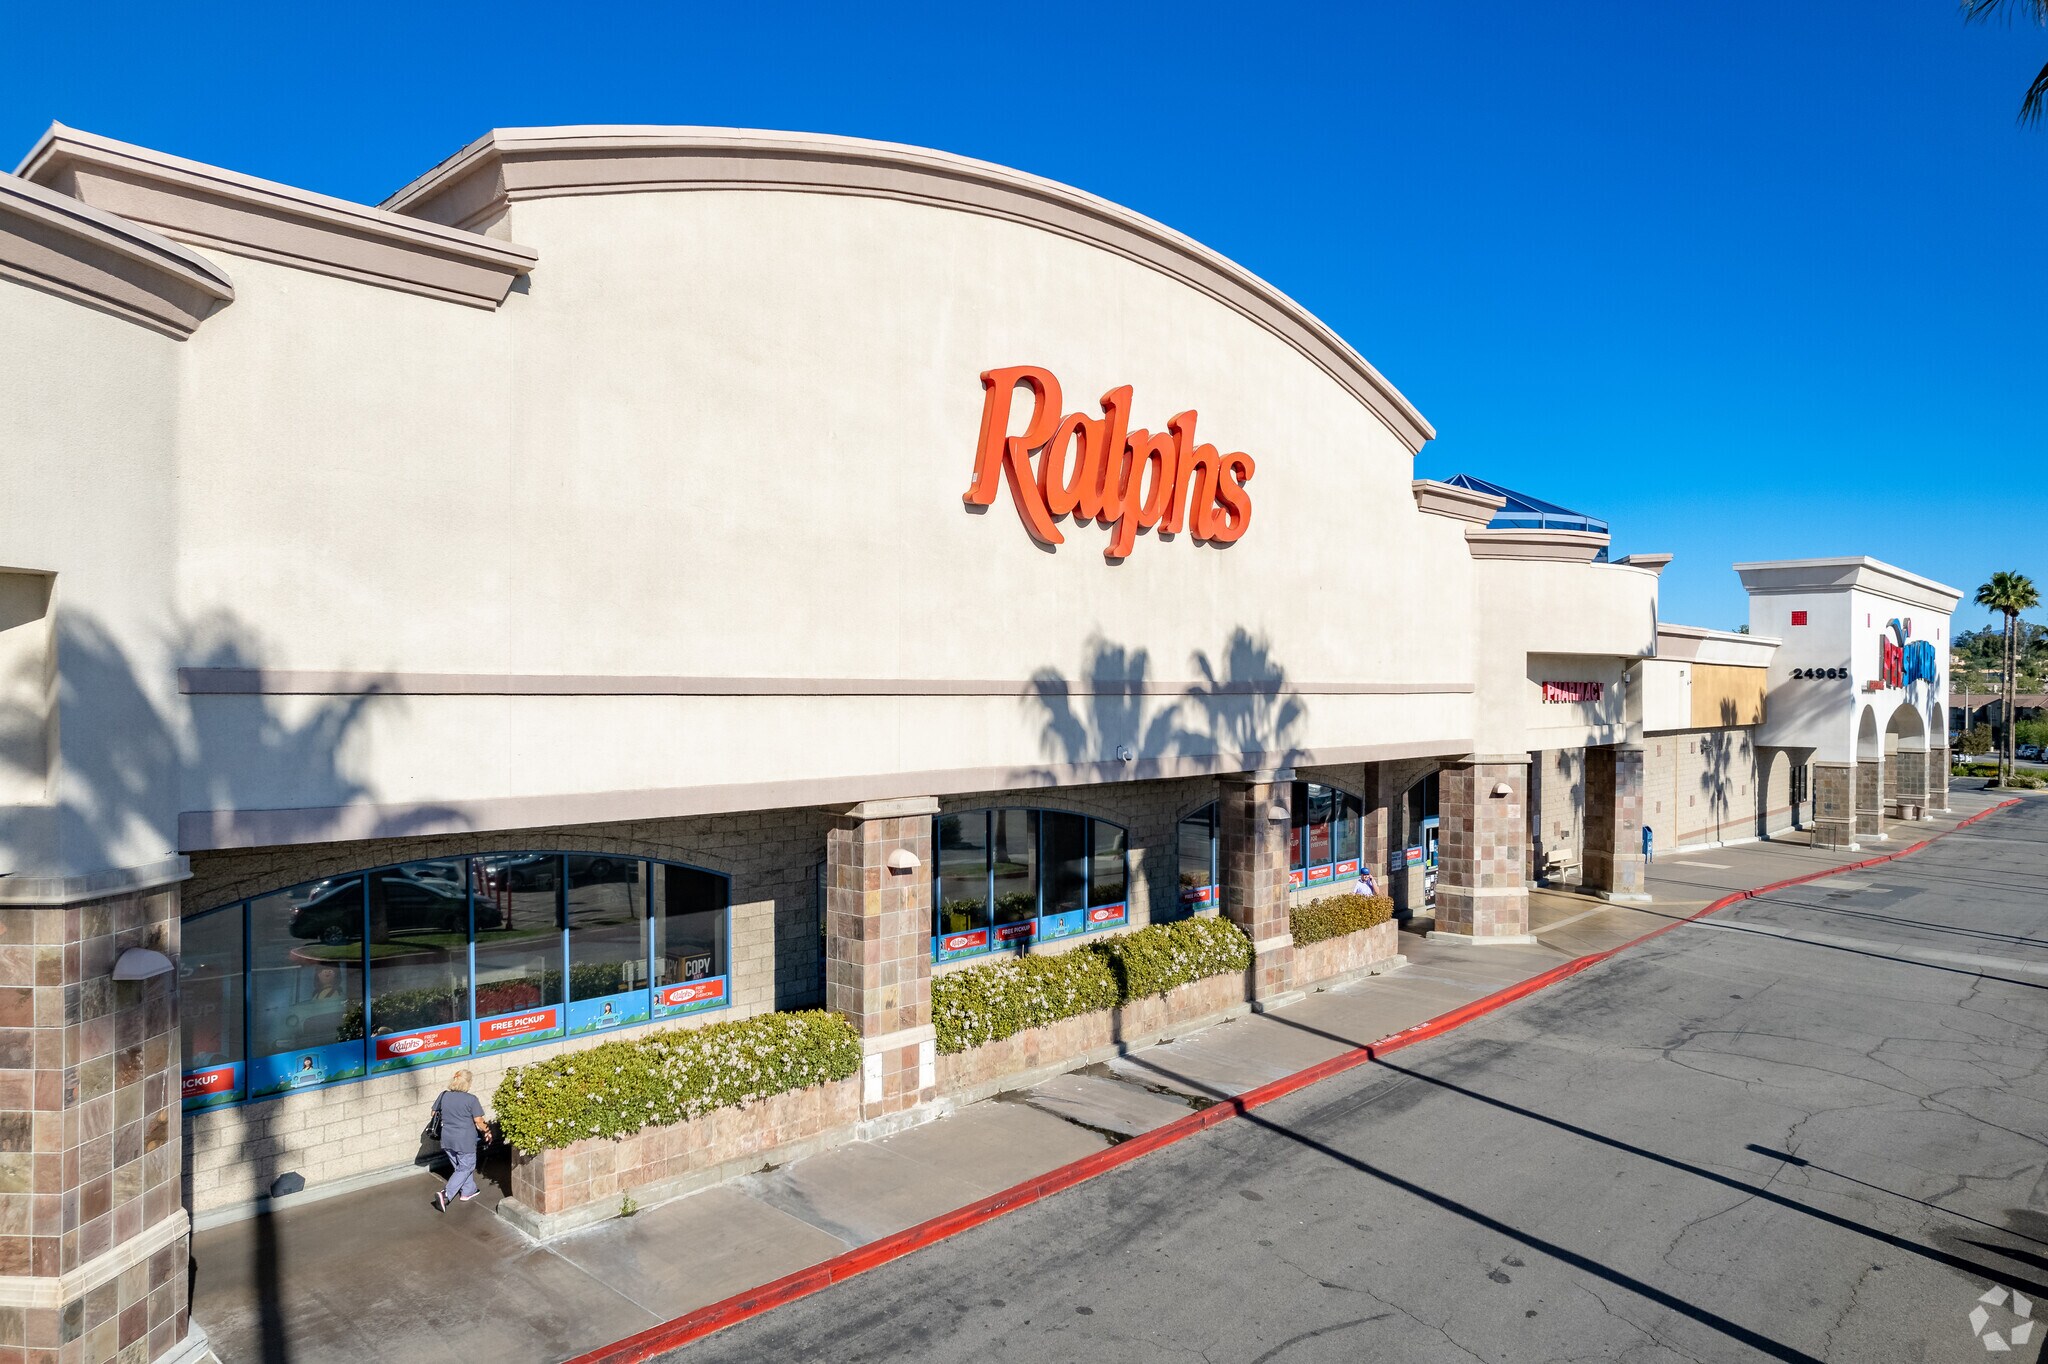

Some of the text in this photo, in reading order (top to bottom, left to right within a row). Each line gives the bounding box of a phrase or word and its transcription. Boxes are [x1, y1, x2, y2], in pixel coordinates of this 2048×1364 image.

[963, 365, 1256, 558] Ralphs
[1793, 667, 1848, 680] 24965
[1542, 681, 1605, 703] PHARMACY
[1014, 925, 1031, 933] PICKUP
[685, 957, 711, 977] COPY
[491, 1020, 513, 1031] FREE
[514, 1014, 545, 1027] PICKUP
[392, 1039, 421, 1053] Ralphs
[181, 1074, 219, 1090] ICKUP
